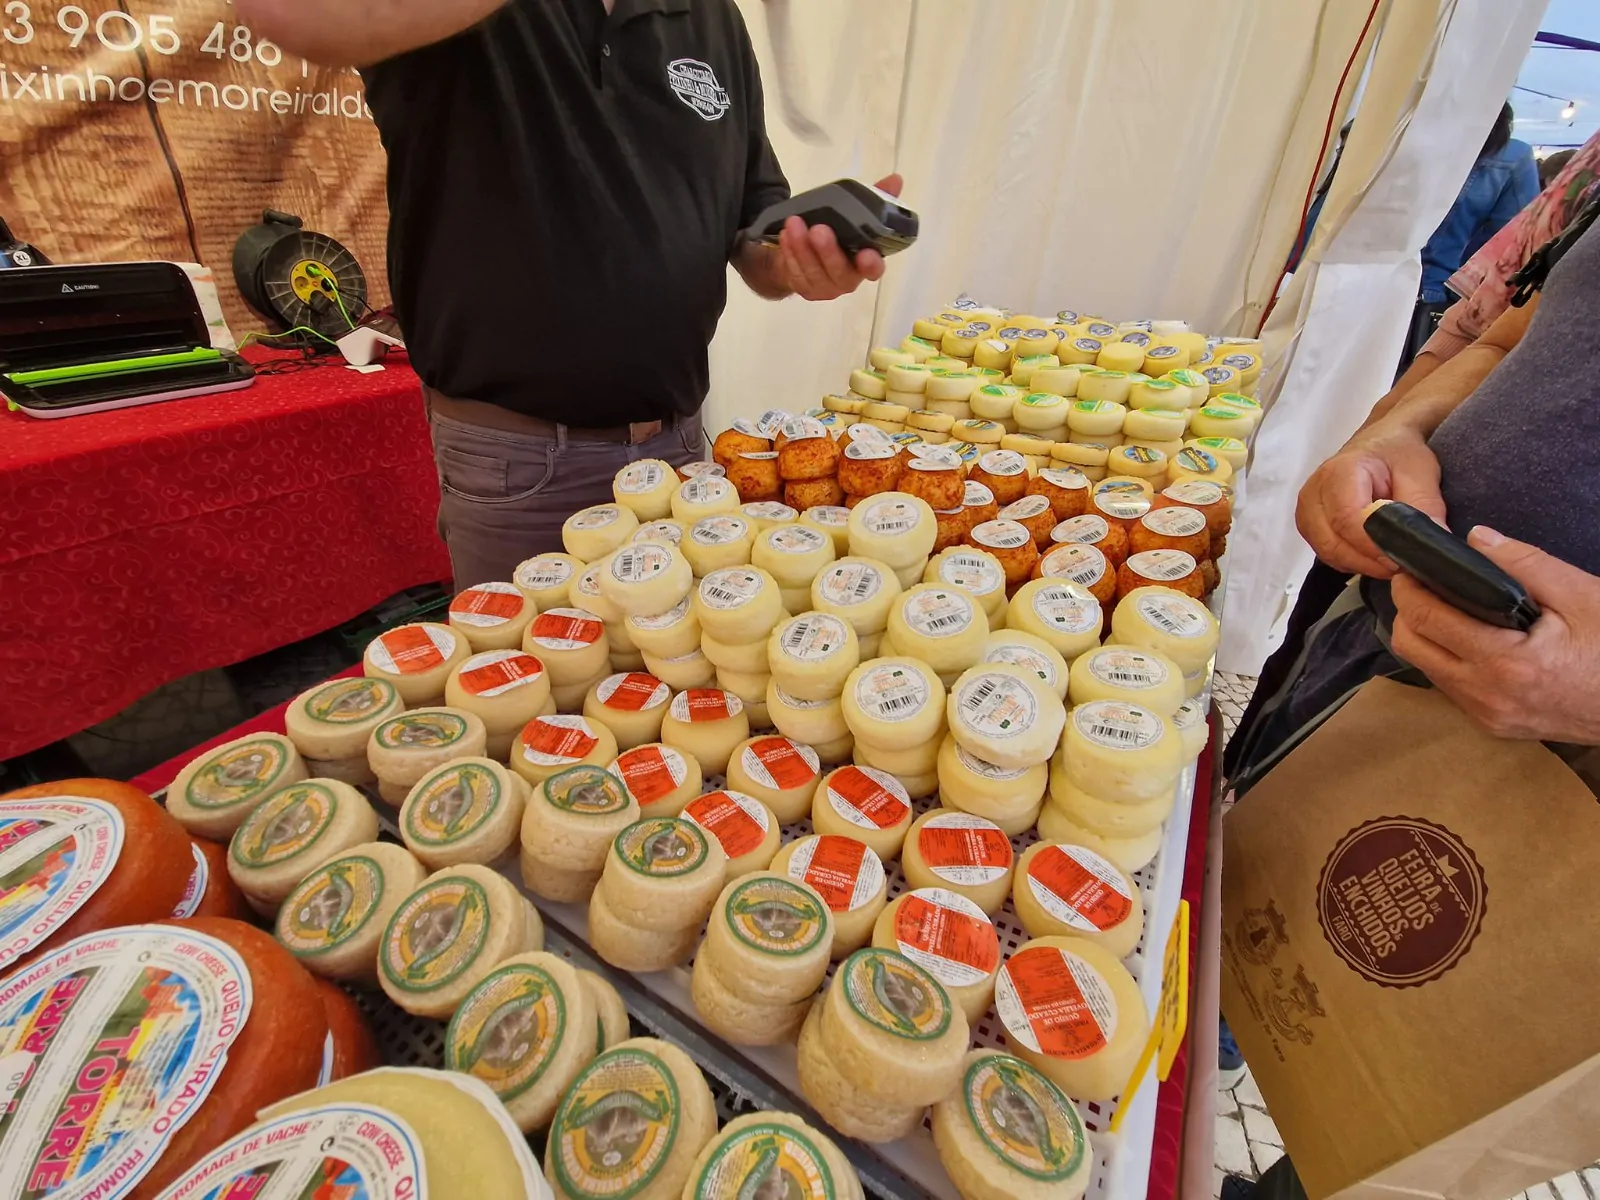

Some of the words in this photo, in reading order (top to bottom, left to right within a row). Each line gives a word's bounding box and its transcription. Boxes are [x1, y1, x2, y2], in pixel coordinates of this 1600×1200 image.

[3, 1, 35, 44] 3
[1377, 857, 1434, 930] QUEIJOS
[1398, 848, 1443, 902] FEIRA
[33, 880, 92, 934] QUEIJO
[1338, 874, 1397, 958] ENCHIDOS
[1360, 869, 1410, 937] VINHOS
[56, 952, 72, 967] DE
[75, 938, 120, 957] VACHE
[195, 951, 229, 979] CHEESE
[218, 979, 240, 1038] QUEIJO
[1042, 1017, 1053, 1025] DE
[1053, 1012, 1079, 1023] QUEIJO
[27, 1027, 142, 1192] TORRE
[242, 1137, 262, 1155] DE
[266, 1120, 312, 1146] VACHE
[356, 1120, 378, 1139] COW
[375, 1134, 406, 1171] CHEESE
